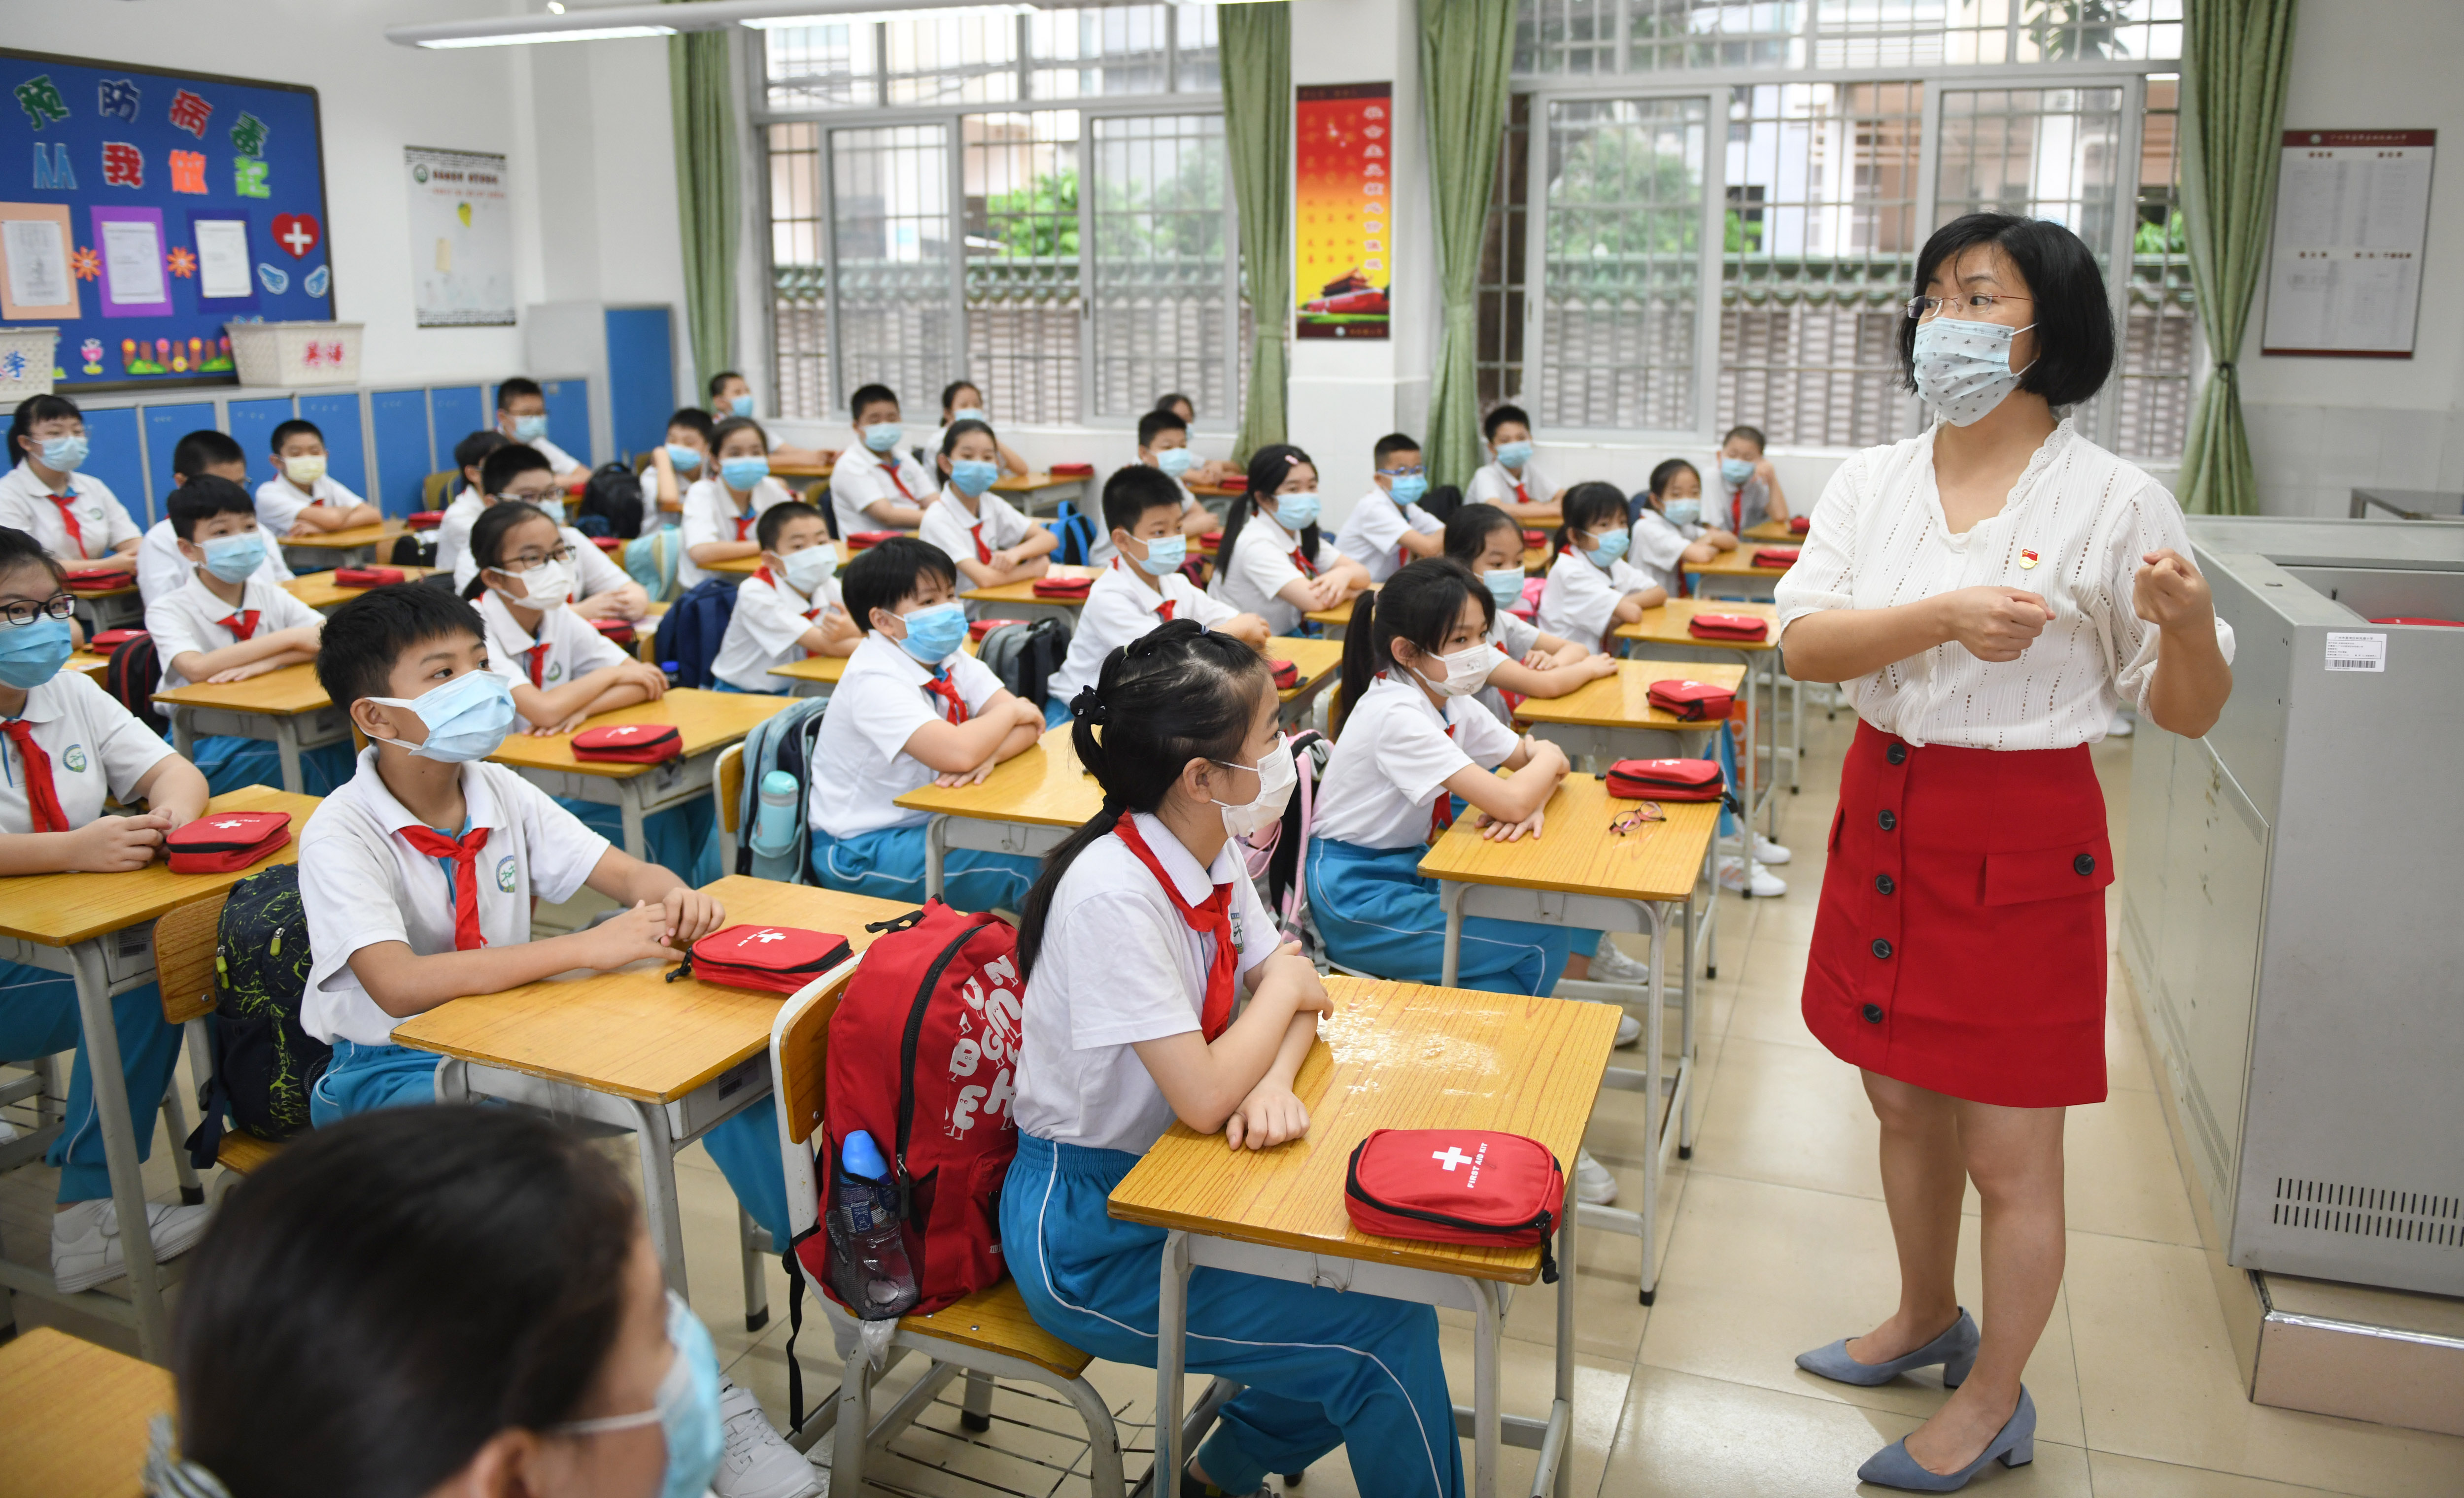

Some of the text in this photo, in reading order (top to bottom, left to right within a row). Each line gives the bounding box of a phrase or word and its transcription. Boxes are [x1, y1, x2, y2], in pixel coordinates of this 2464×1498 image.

[14, 74, 270, 158] 预防病毒
[33, 141, 270, 198] 从我做起
[0, 350, 25, 380] 学
[949, 1038, 981, 1077] B
[1467, 1142, 1488, 1189] FIRST AID KIT
